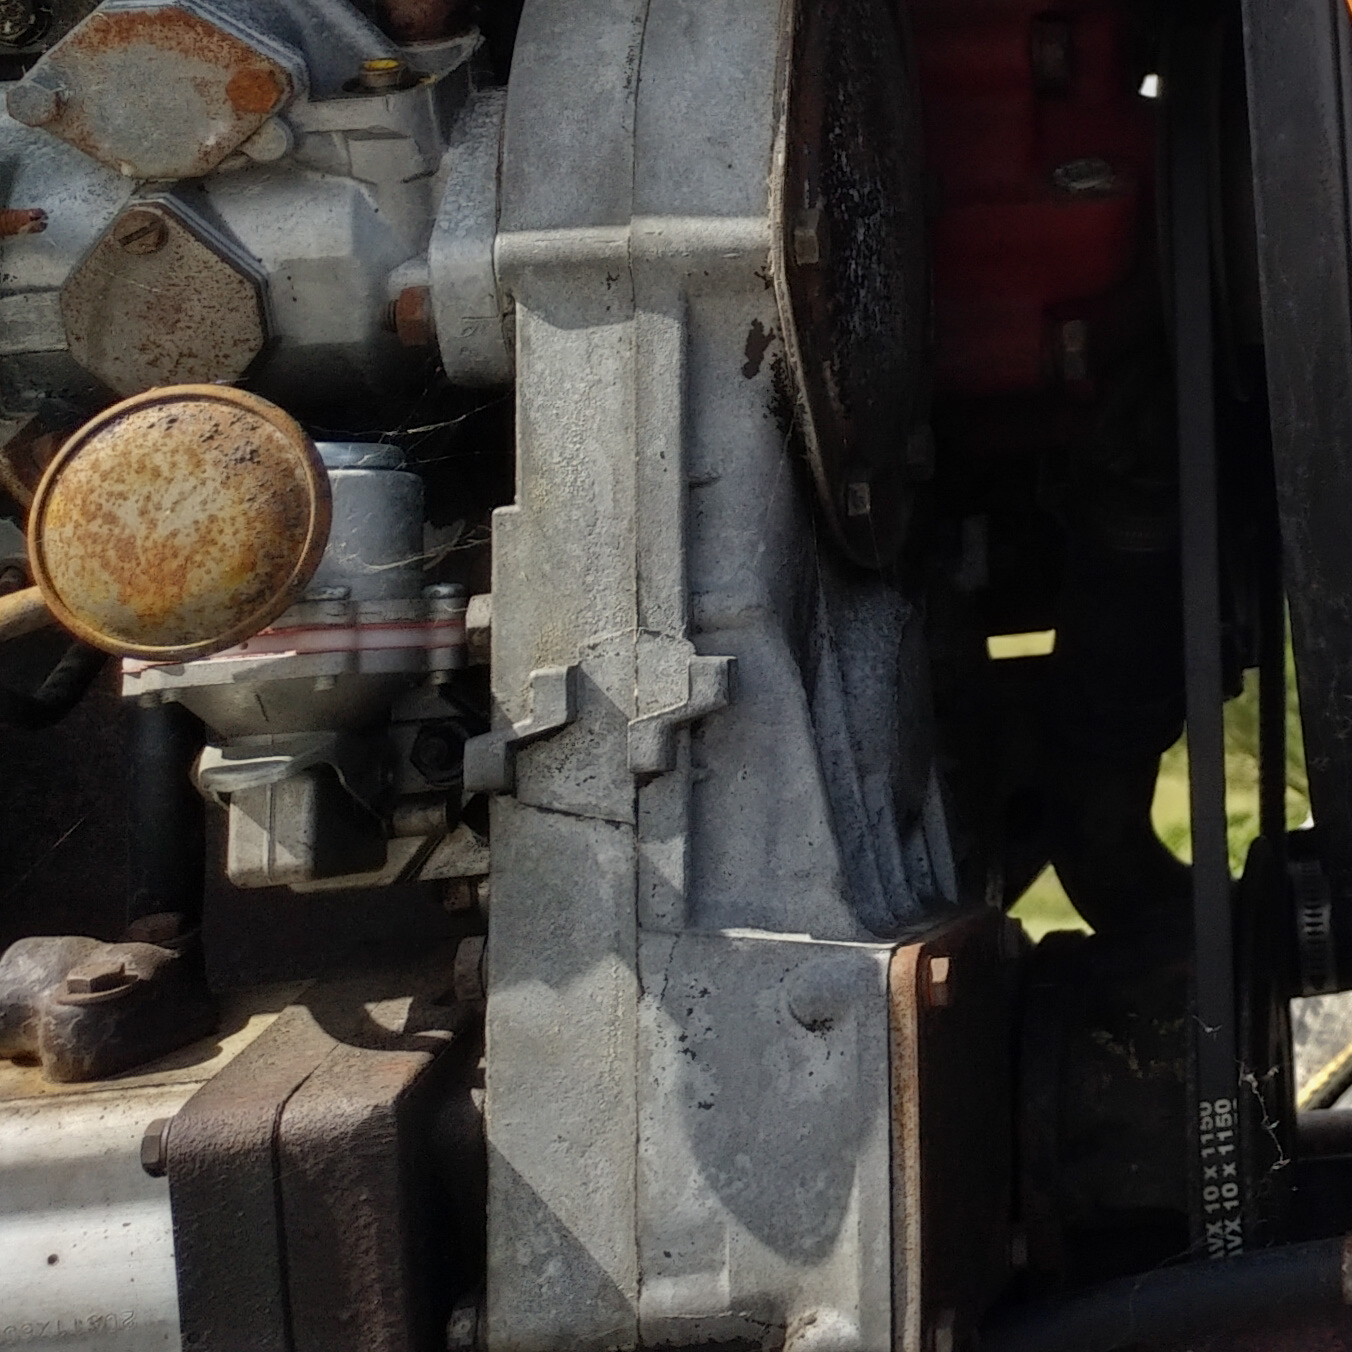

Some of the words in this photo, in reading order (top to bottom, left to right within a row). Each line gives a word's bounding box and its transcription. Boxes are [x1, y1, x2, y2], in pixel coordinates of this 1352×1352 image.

[1214, 1098, 1234, 1156] 1150
[1203, 1185, 1220, 1214] 10
[1221, 1182, 1239, 1211] 10
